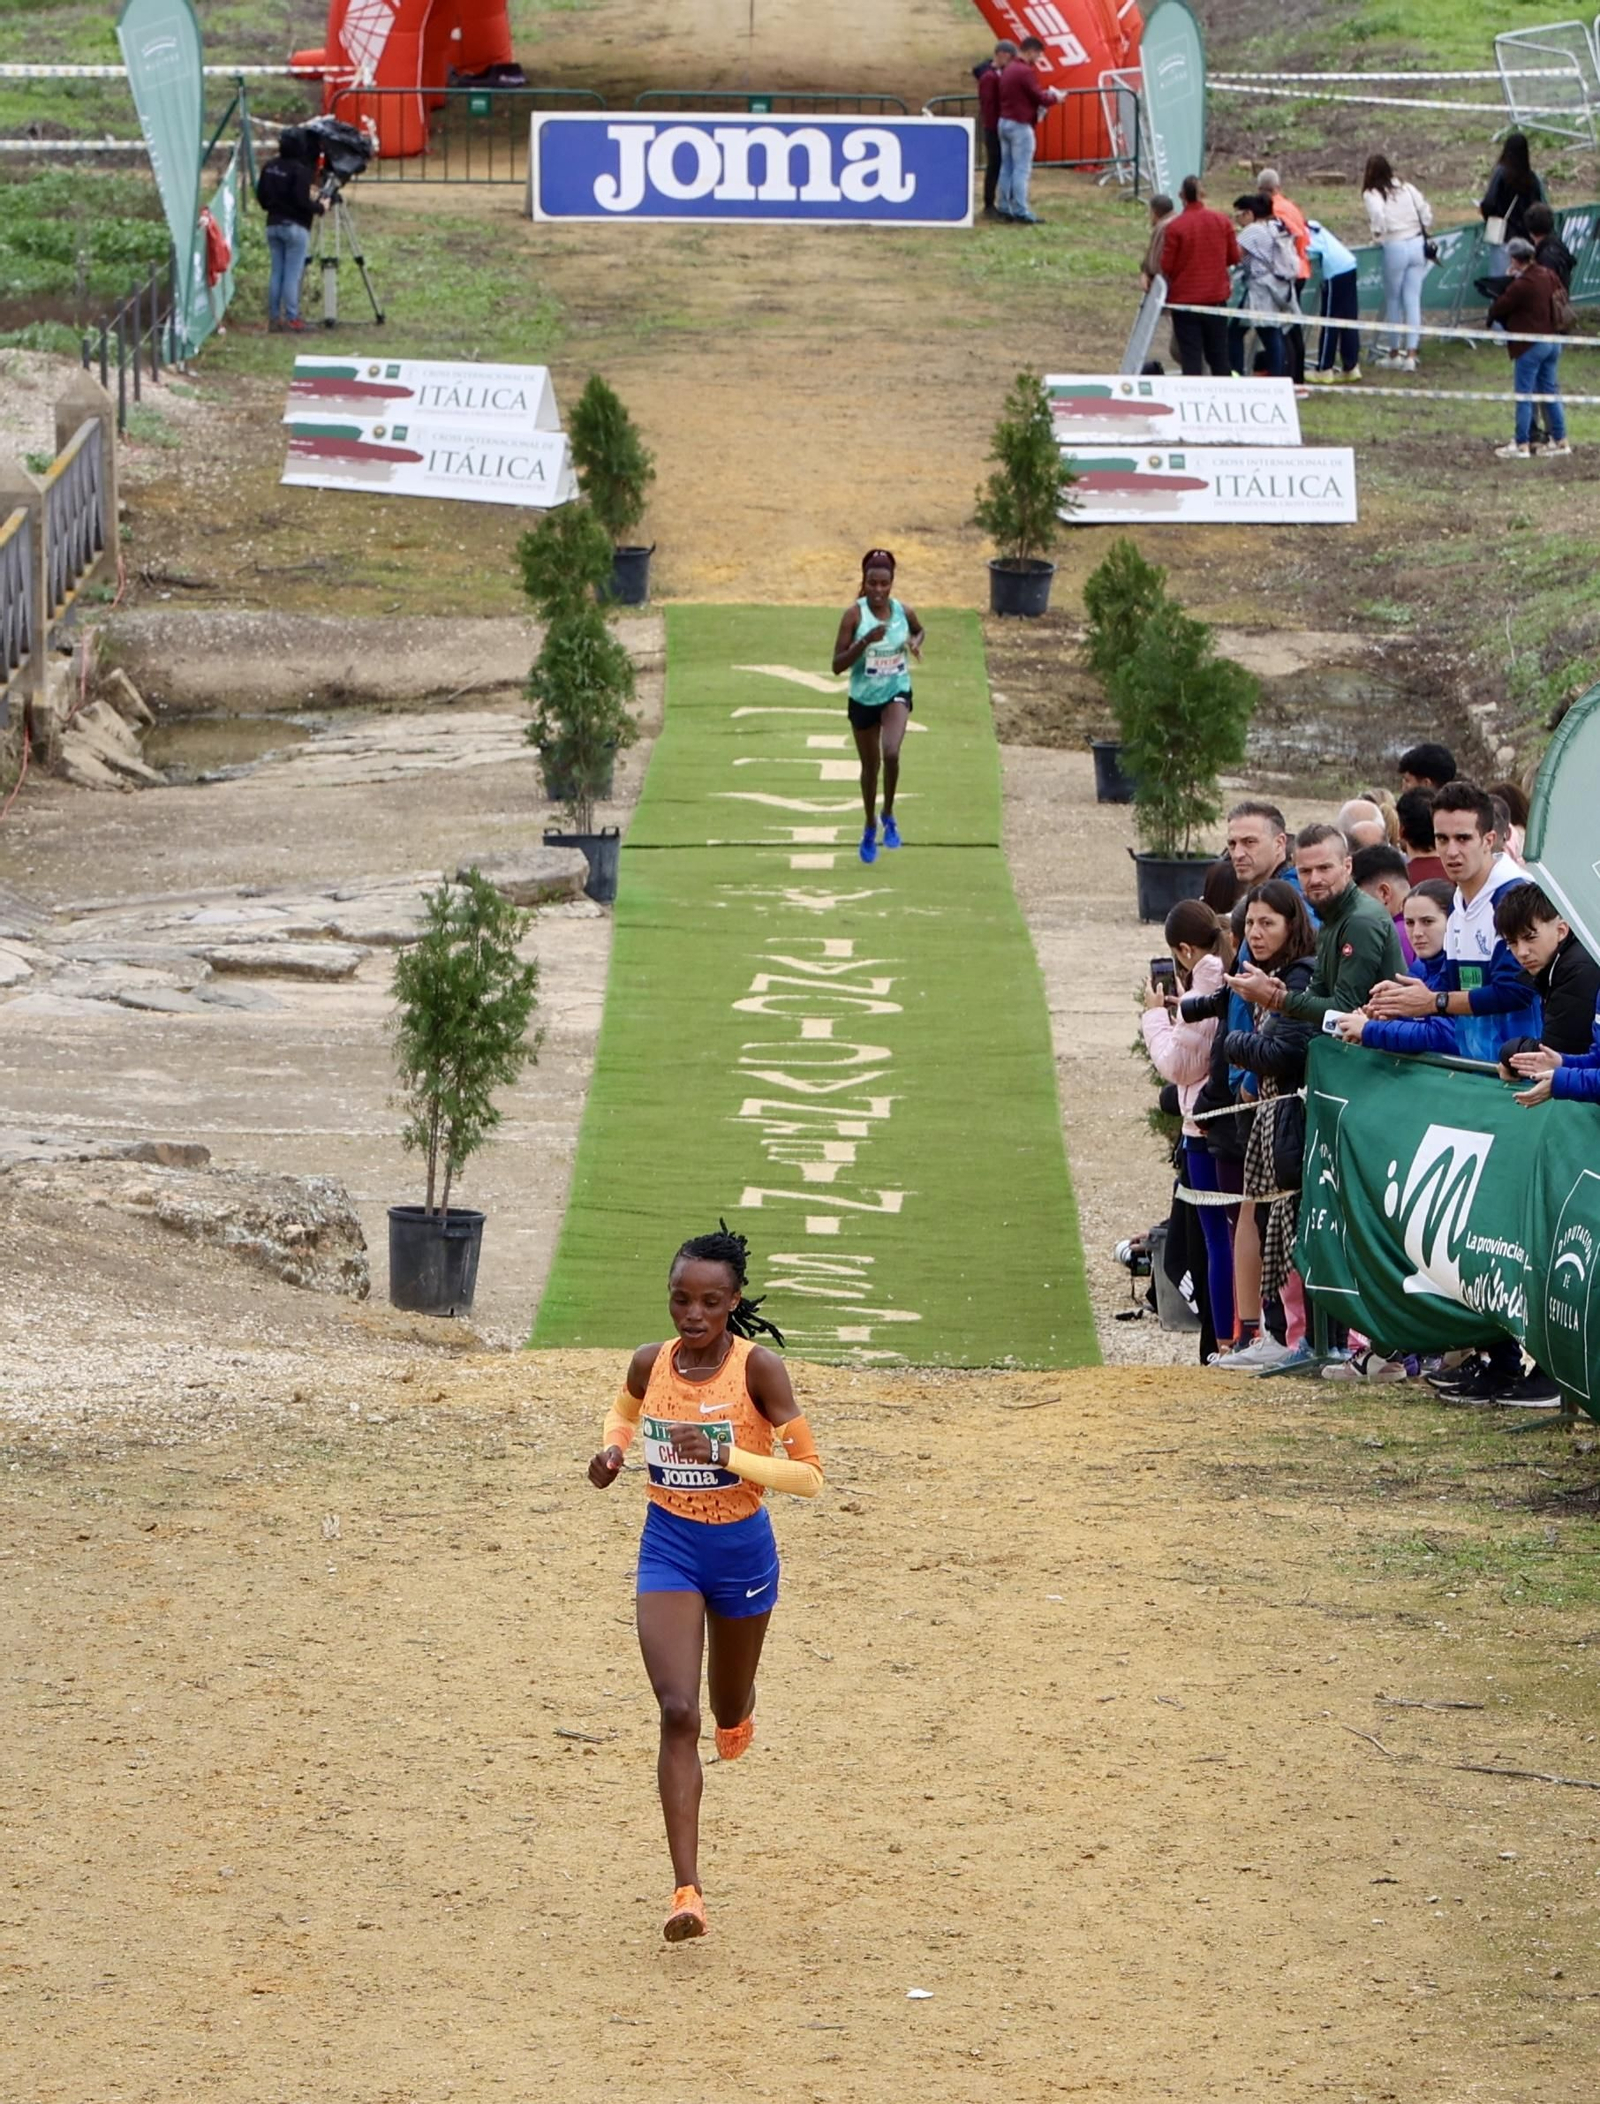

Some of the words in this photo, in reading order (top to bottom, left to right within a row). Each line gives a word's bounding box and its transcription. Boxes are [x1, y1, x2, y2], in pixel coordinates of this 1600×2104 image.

[418, 380, 527, 411] ITÁLICA
[1179, 395, 1287, 424] ITÁLICA
[428, 445, 547, 482] ITÁLICA
[1215, 468, 1343, 499] ITÁLICA
[1549, 1296, 1579, 1332] SEVILLA
